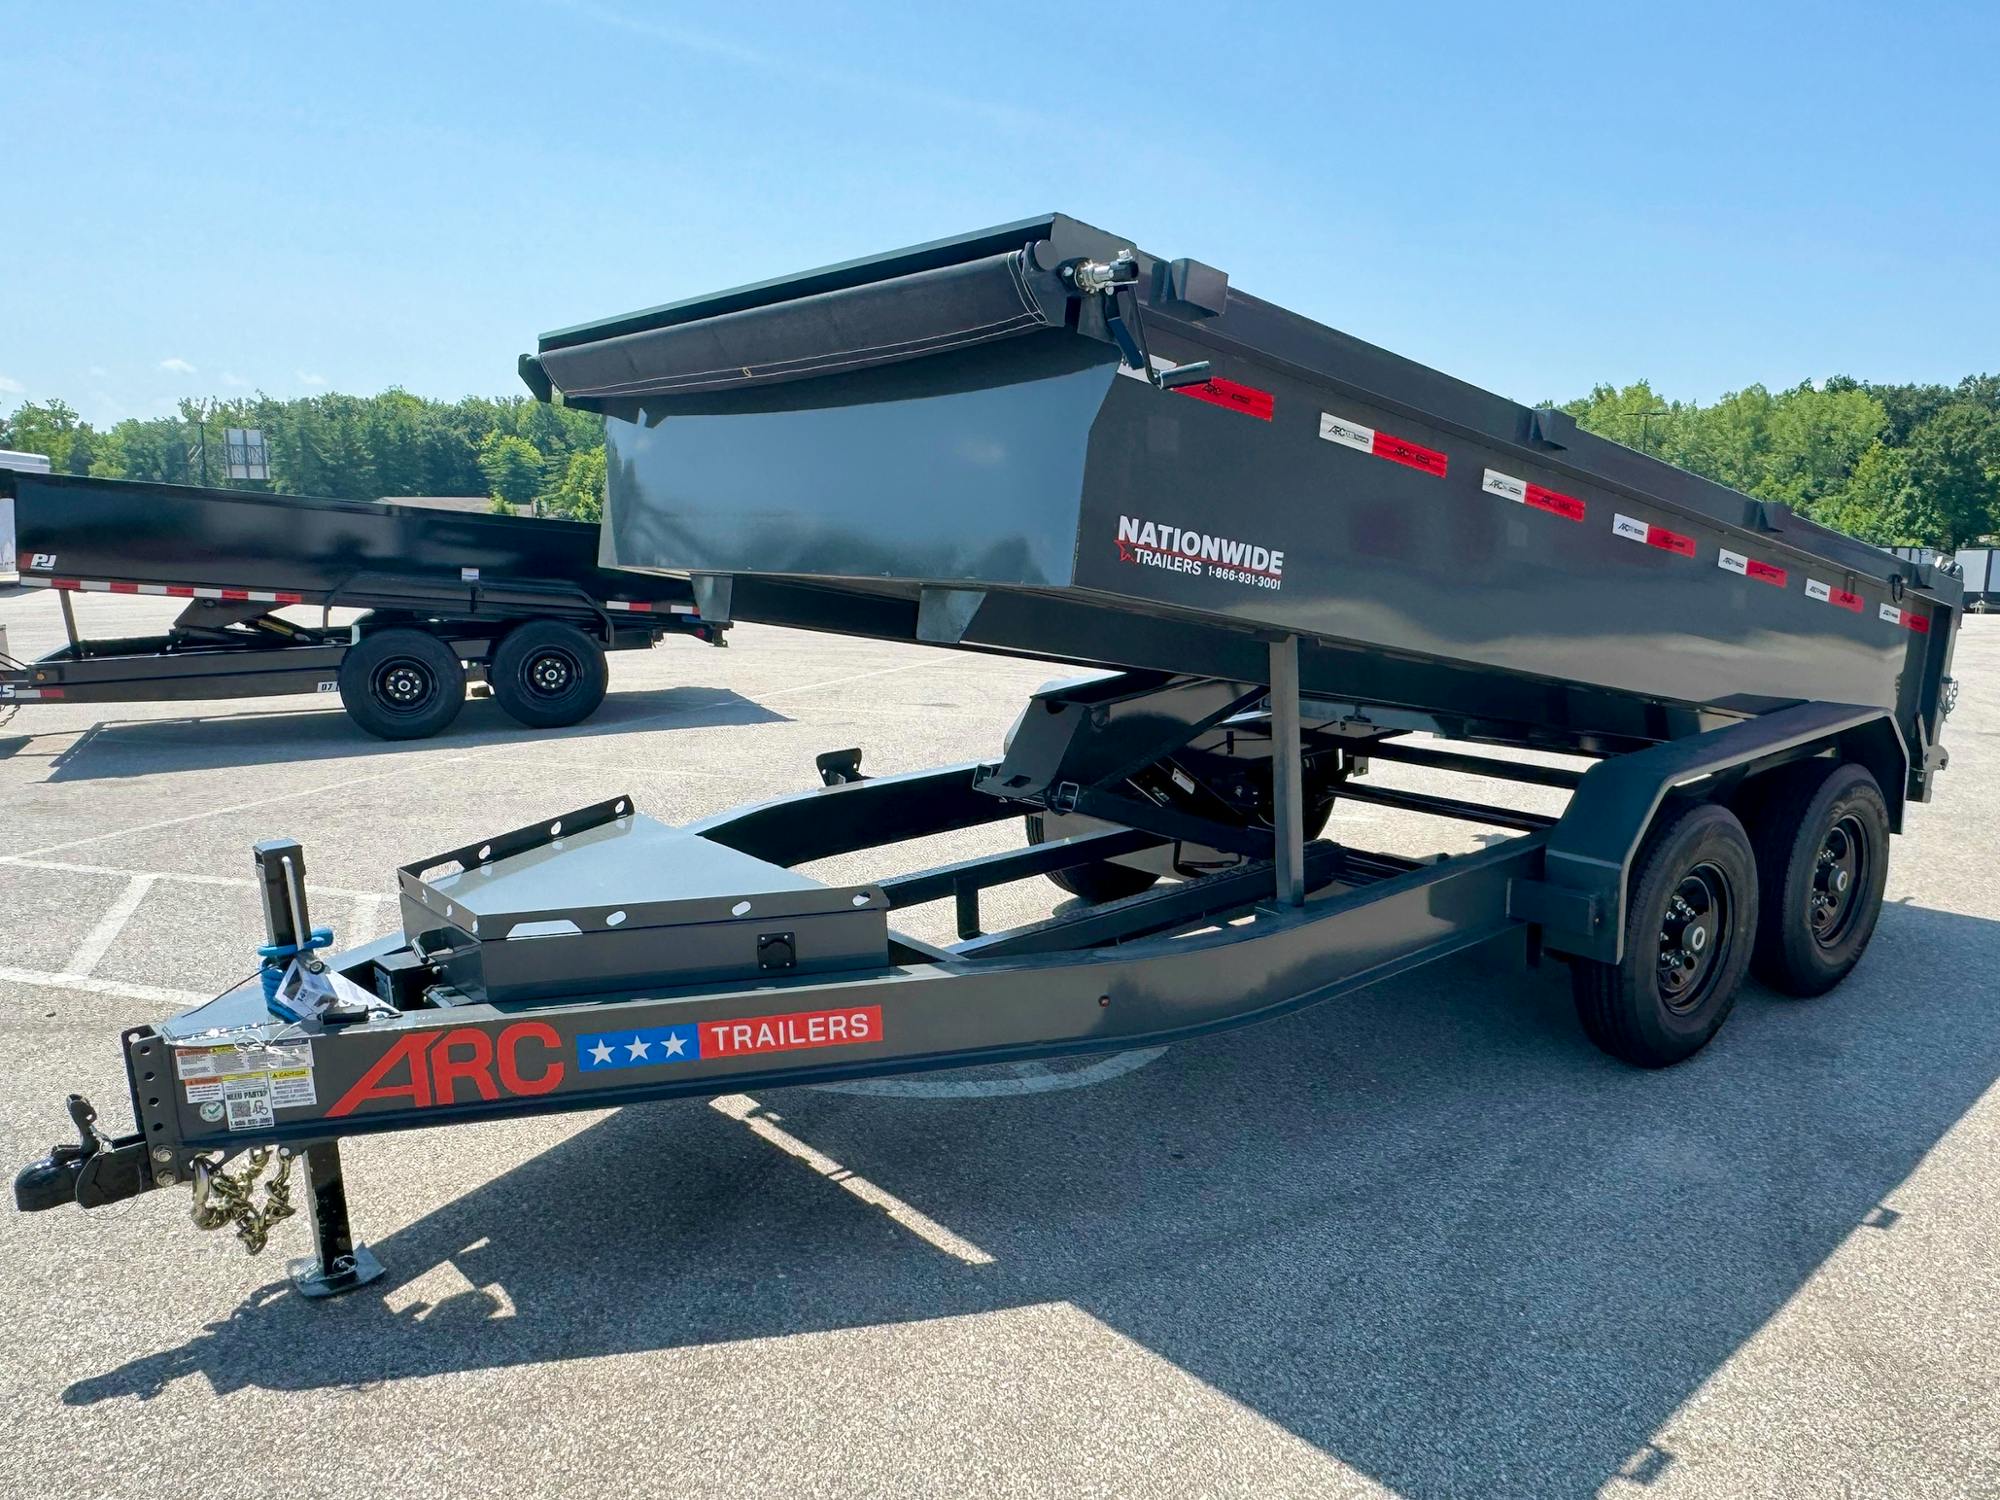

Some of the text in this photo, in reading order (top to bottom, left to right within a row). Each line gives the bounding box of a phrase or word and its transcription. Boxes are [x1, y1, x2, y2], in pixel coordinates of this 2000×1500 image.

[31, 553, 57, 569] PJ
[1117, 514, 1285, 575] NATIONWIDE
[1134, 547, 1282, 591] TRAILERS 1-866-931-3001
[324, 1012, 869, 1118] ARC TRAILERS
[226, 1091, 243, 1101] NEED
